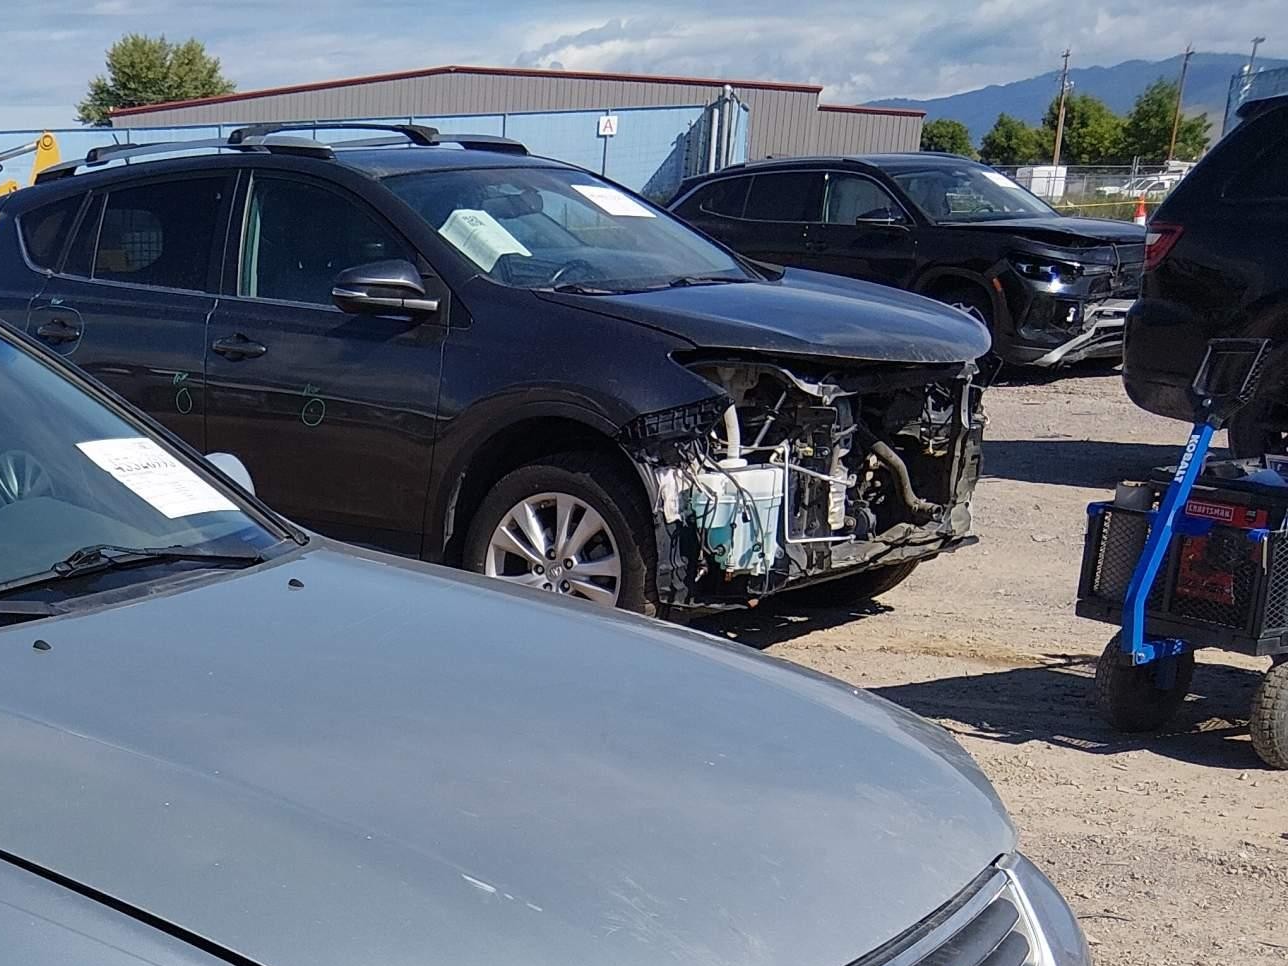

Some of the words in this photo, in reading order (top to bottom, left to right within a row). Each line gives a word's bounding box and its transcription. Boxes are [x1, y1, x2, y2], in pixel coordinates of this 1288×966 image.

[602, 118, 614, 133] A
[1173, 434, 1201, 484] KOBALT
[1187, 503, 1231, 518] CRAFTSMAN
